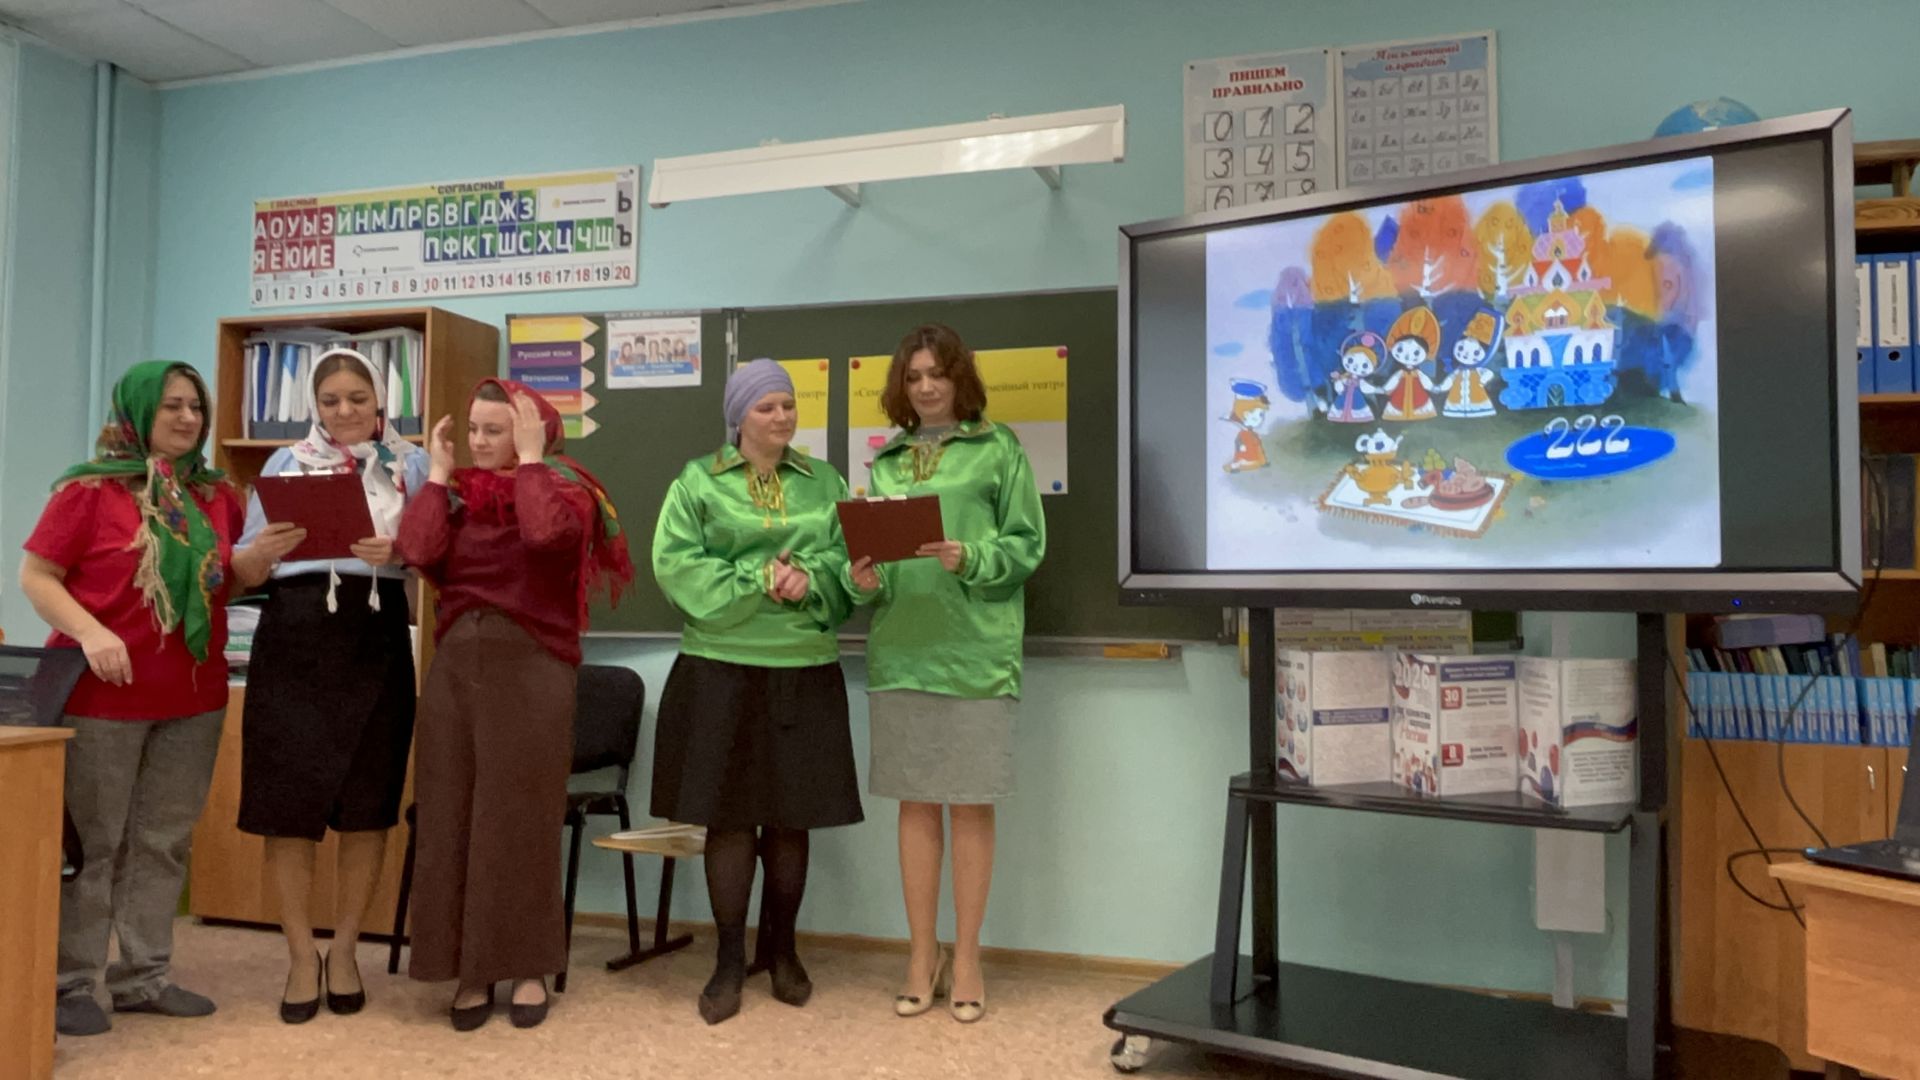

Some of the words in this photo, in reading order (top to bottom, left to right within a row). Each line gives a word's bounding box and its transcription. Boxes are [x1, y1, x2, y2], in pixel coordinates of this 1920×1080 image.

[1229, 67, 1286, 83] ПИШЕМ
[1212, 80, 1304, 99] ПРАВИЛЬНО
[1214, 111, 1233, 142] 0
[1259, 106, 1274, 138] 1
[1293, 103, 1315, 135] 2
[1213, 148, 1233, 179] 3
[1257, 144, 1273, 175] 4
[1292, 140, 1315, 171] 5
[438, 180, 505, 195] СОГЛАСНЫЕ
[255, 289, 262, 302] 0
[273, 287, 279, 300] 1
[288, 286, 295, 300] 2
[305, 285, 312, 299] 3
[322, 285, 330, 297] 4
[339, 283, 346, 297] 5
[357, 281, 364, 295] 6
[374, 281, 381, 294] 7
[392, 279, 399, 293] 8
[410, 278, 417, 292] 9
[426, 277, 438, 291] 10
[444, 276, 456, 290] 11
[462, 275, 475, 289] 12
[480, 274, 494, 288] 13
[499, 273, 513, 286] 14
[518, 271, 532, 286] 15
[537, 270, 551, 284] 16
[556, 269, 571, 283] 17
[576, 268, 590, 282] 18
[595, 267, 610, 281] 19
[615, 266, 630, 280] 20
[518, 350, 552, 360] Русский
[553, 350, 573, 358] язык
[521, 374, 570, 383] Математика
[1444, 689, 1459, 702] 30
